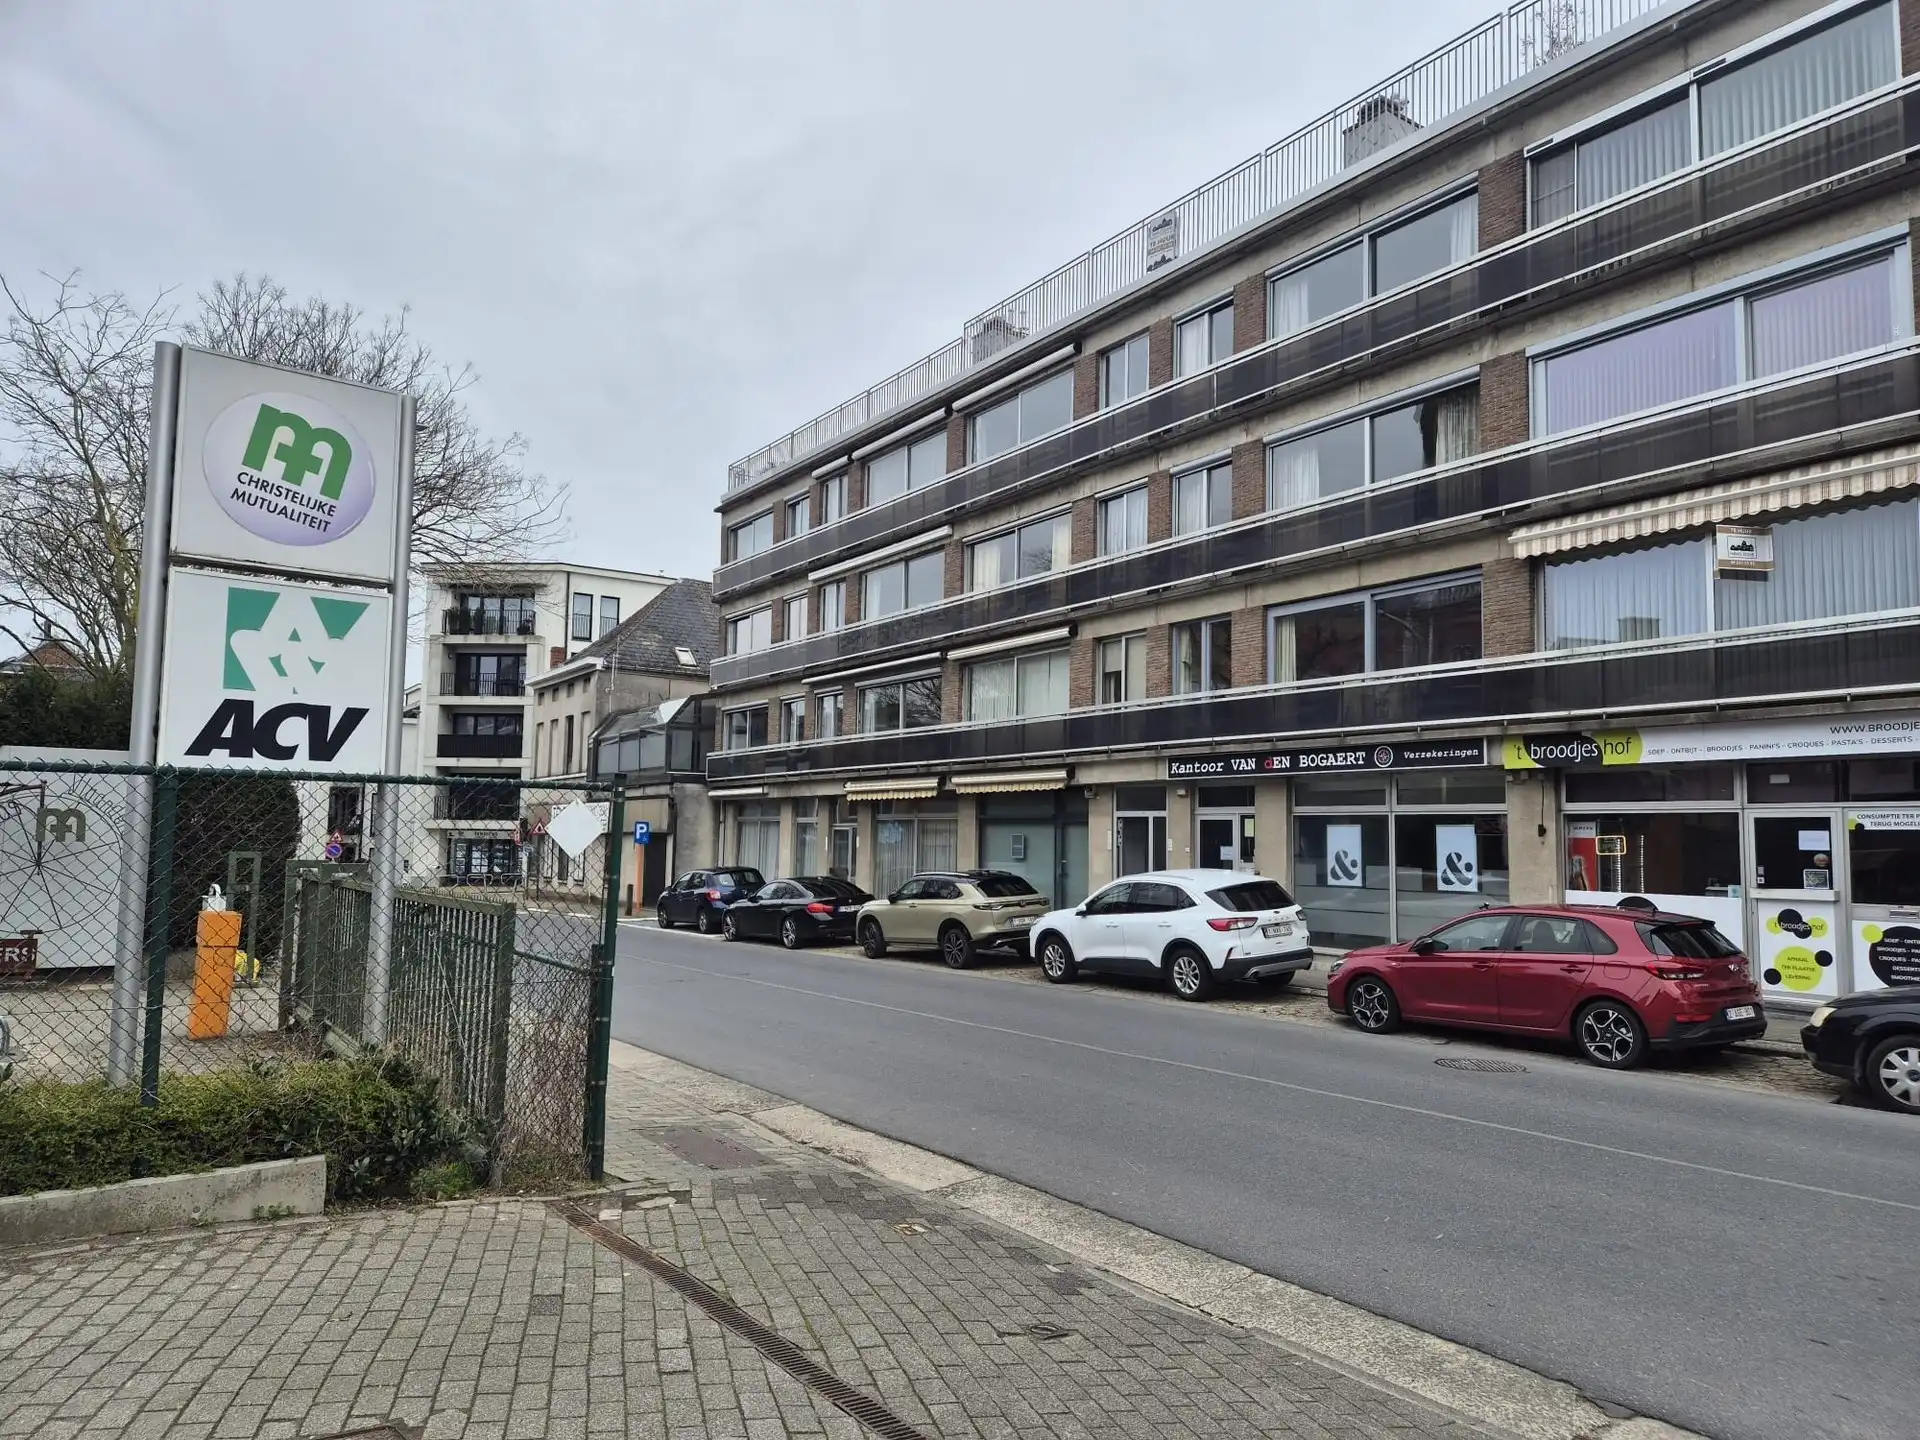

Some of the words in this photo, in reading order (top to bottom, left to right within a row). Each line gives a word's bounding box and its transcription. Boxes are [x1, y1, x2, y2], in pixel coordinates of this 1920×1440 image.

[236, 471, 337, 517] CHRISTELIJKE
[230, 487, 331, 533] MUTUALITEIT
[183, 698, 370, 761] ACV
[1403, 749, 1479, 759] Verzekeringen
[1530, 741, 1599, 762] broodjes
[1603, 736, 1632, 755] hof
[1706, 744, 1743, 752] BROODJES
[1787, 740, 1825, 749] CROQUES
[1871, 735, 1913, 744] DESSERTS
[1171, 760, 1225, 774] Kantoor
[1230, 758, 1257, 771] VAN
[1298, 751, 1366, 767] BOGAERT
[636, 823, 648, 839] P
